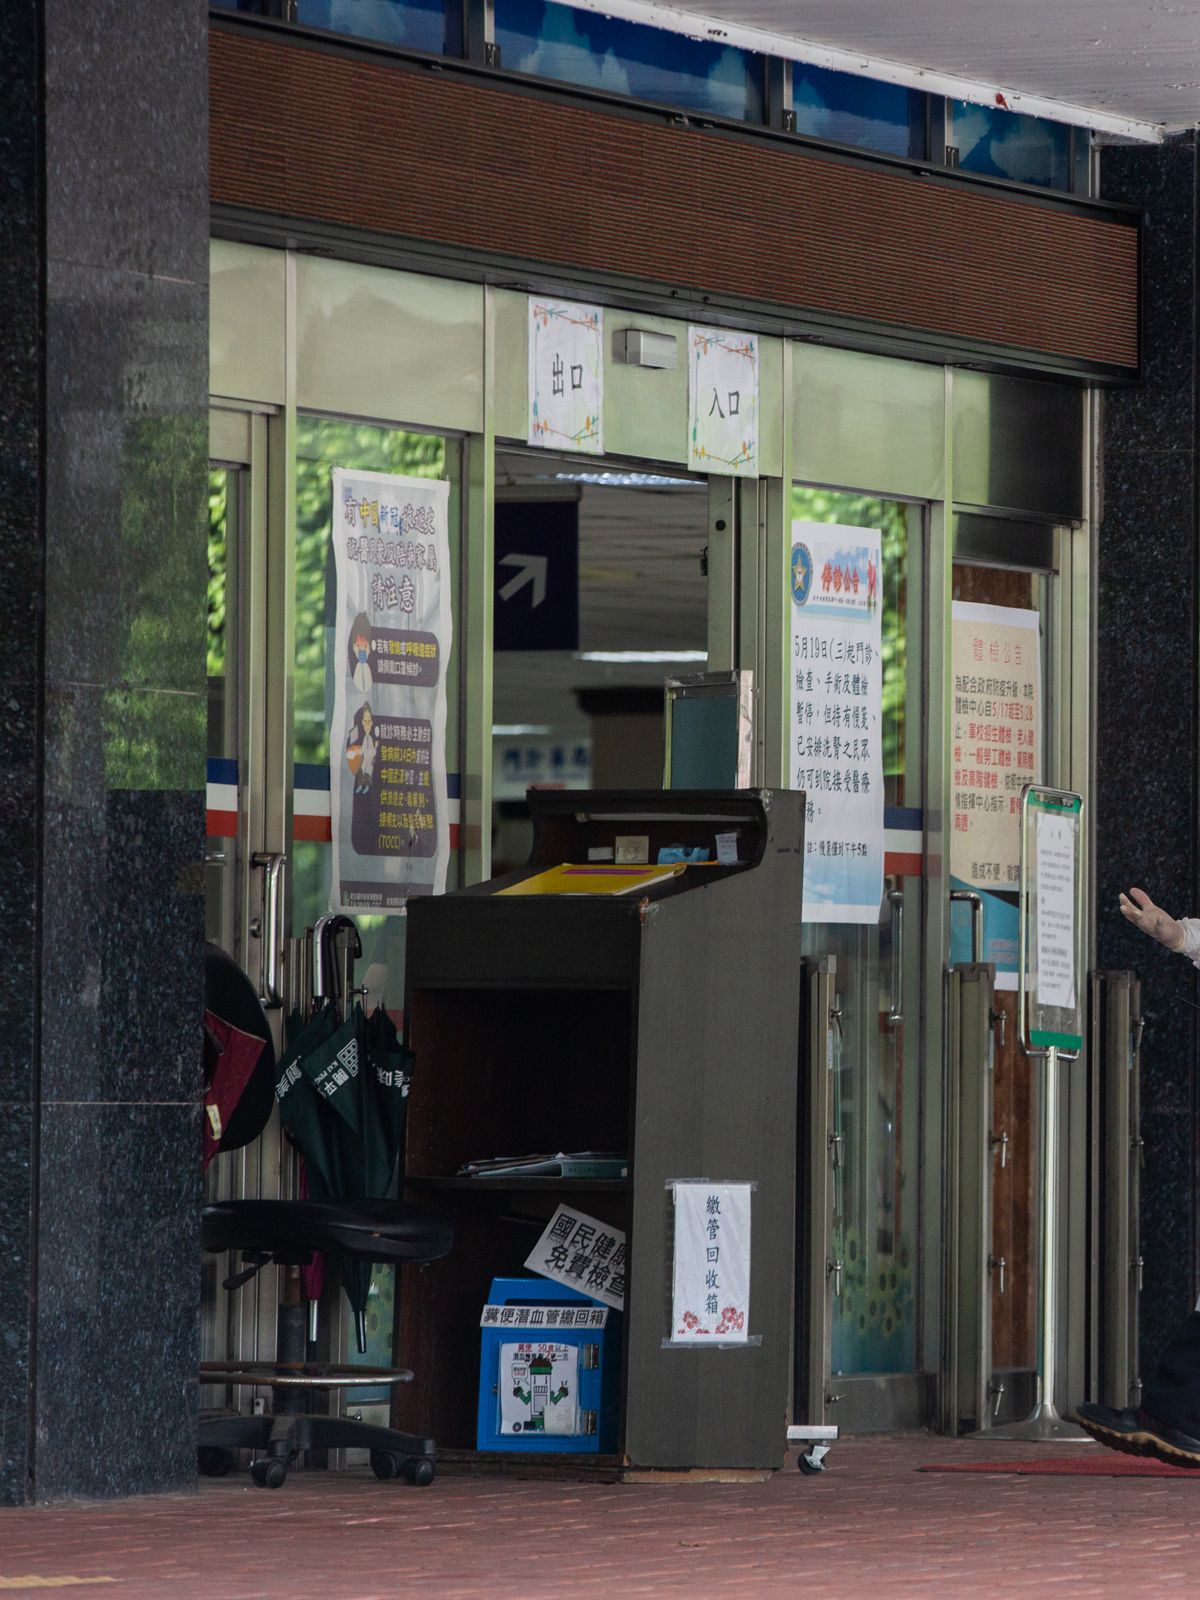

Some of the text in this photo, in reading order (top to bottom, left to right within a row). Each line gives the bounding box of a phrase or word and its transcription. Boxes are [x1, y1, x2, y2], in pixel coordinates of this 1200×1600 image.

[551, 352, 584, 397] 出口
[708, 387, 741, 419] 入口
[371, 572, 415, 614] 請注意
[821, 561, 861, 595] 停診公告
[796, 735, 871, 762] 已安排洗腎之民眾
[796, 767, 871, 794] 仍可到院接受醫療
[805, 800, 822, 823] 務。
[324, 1067, 349, 1096] 開平
[704, 1195, 721, 1315] 繳管回收箱
[484, 1306, 605, 1325] 糞便潛血管繳回箱
